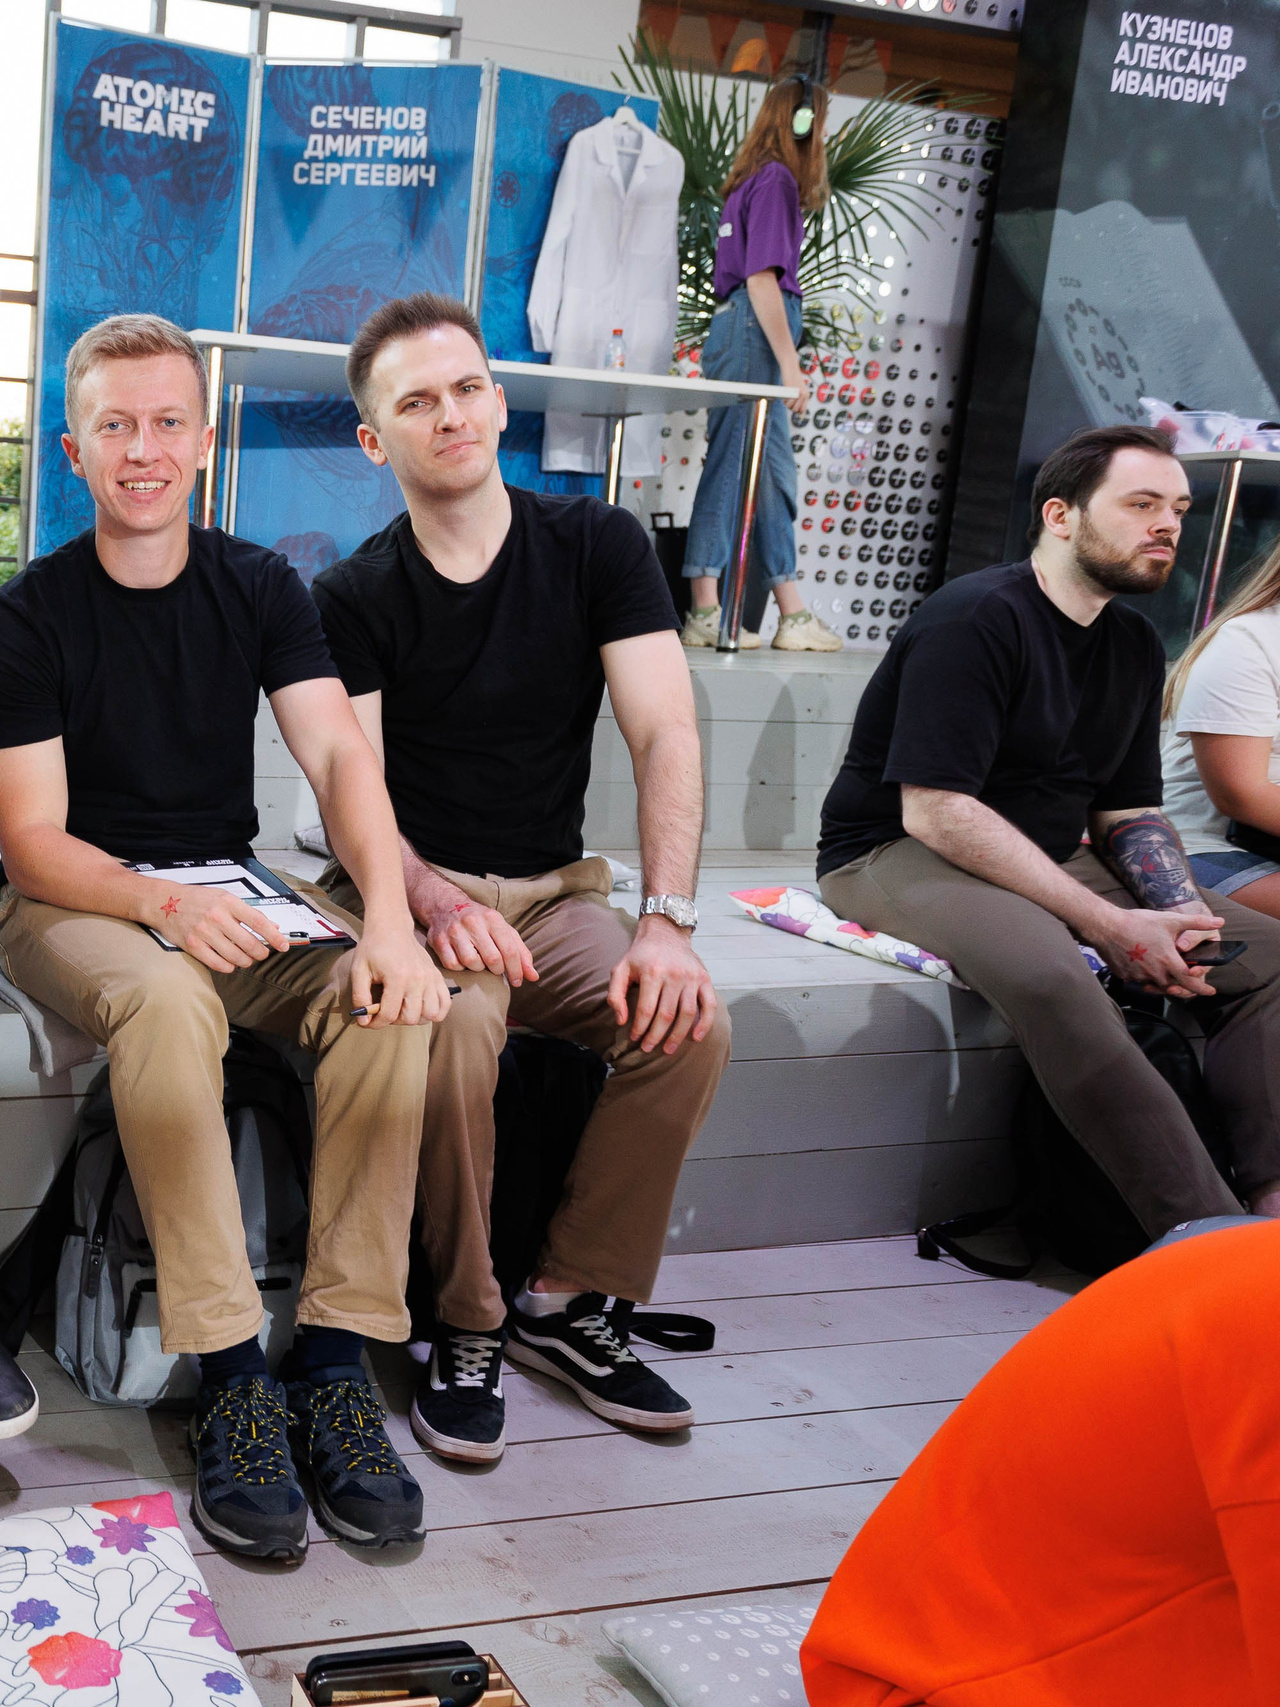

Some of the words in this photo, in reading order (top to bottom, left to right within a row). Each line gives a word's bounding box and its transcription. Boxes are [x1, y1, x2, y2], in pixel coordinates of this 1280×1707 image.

[1119, 11, 1233, 50] КУЗНЕЦОВ
[1113, 40, 1247, 82] АЛЕКСАНДР
[93, 73, 215, 118] ATOMIC
[1110, 68, 1228, 106] ИВАНОВИЧ
[100, 100, 209, 143] HEART
[310, 105, 427, 129] СЕЧЕНОВ
[303, 131, 428, 159] ДМИТРИЙ
[293, 162, 436, 187] СЕРГЕЕВИЧ
